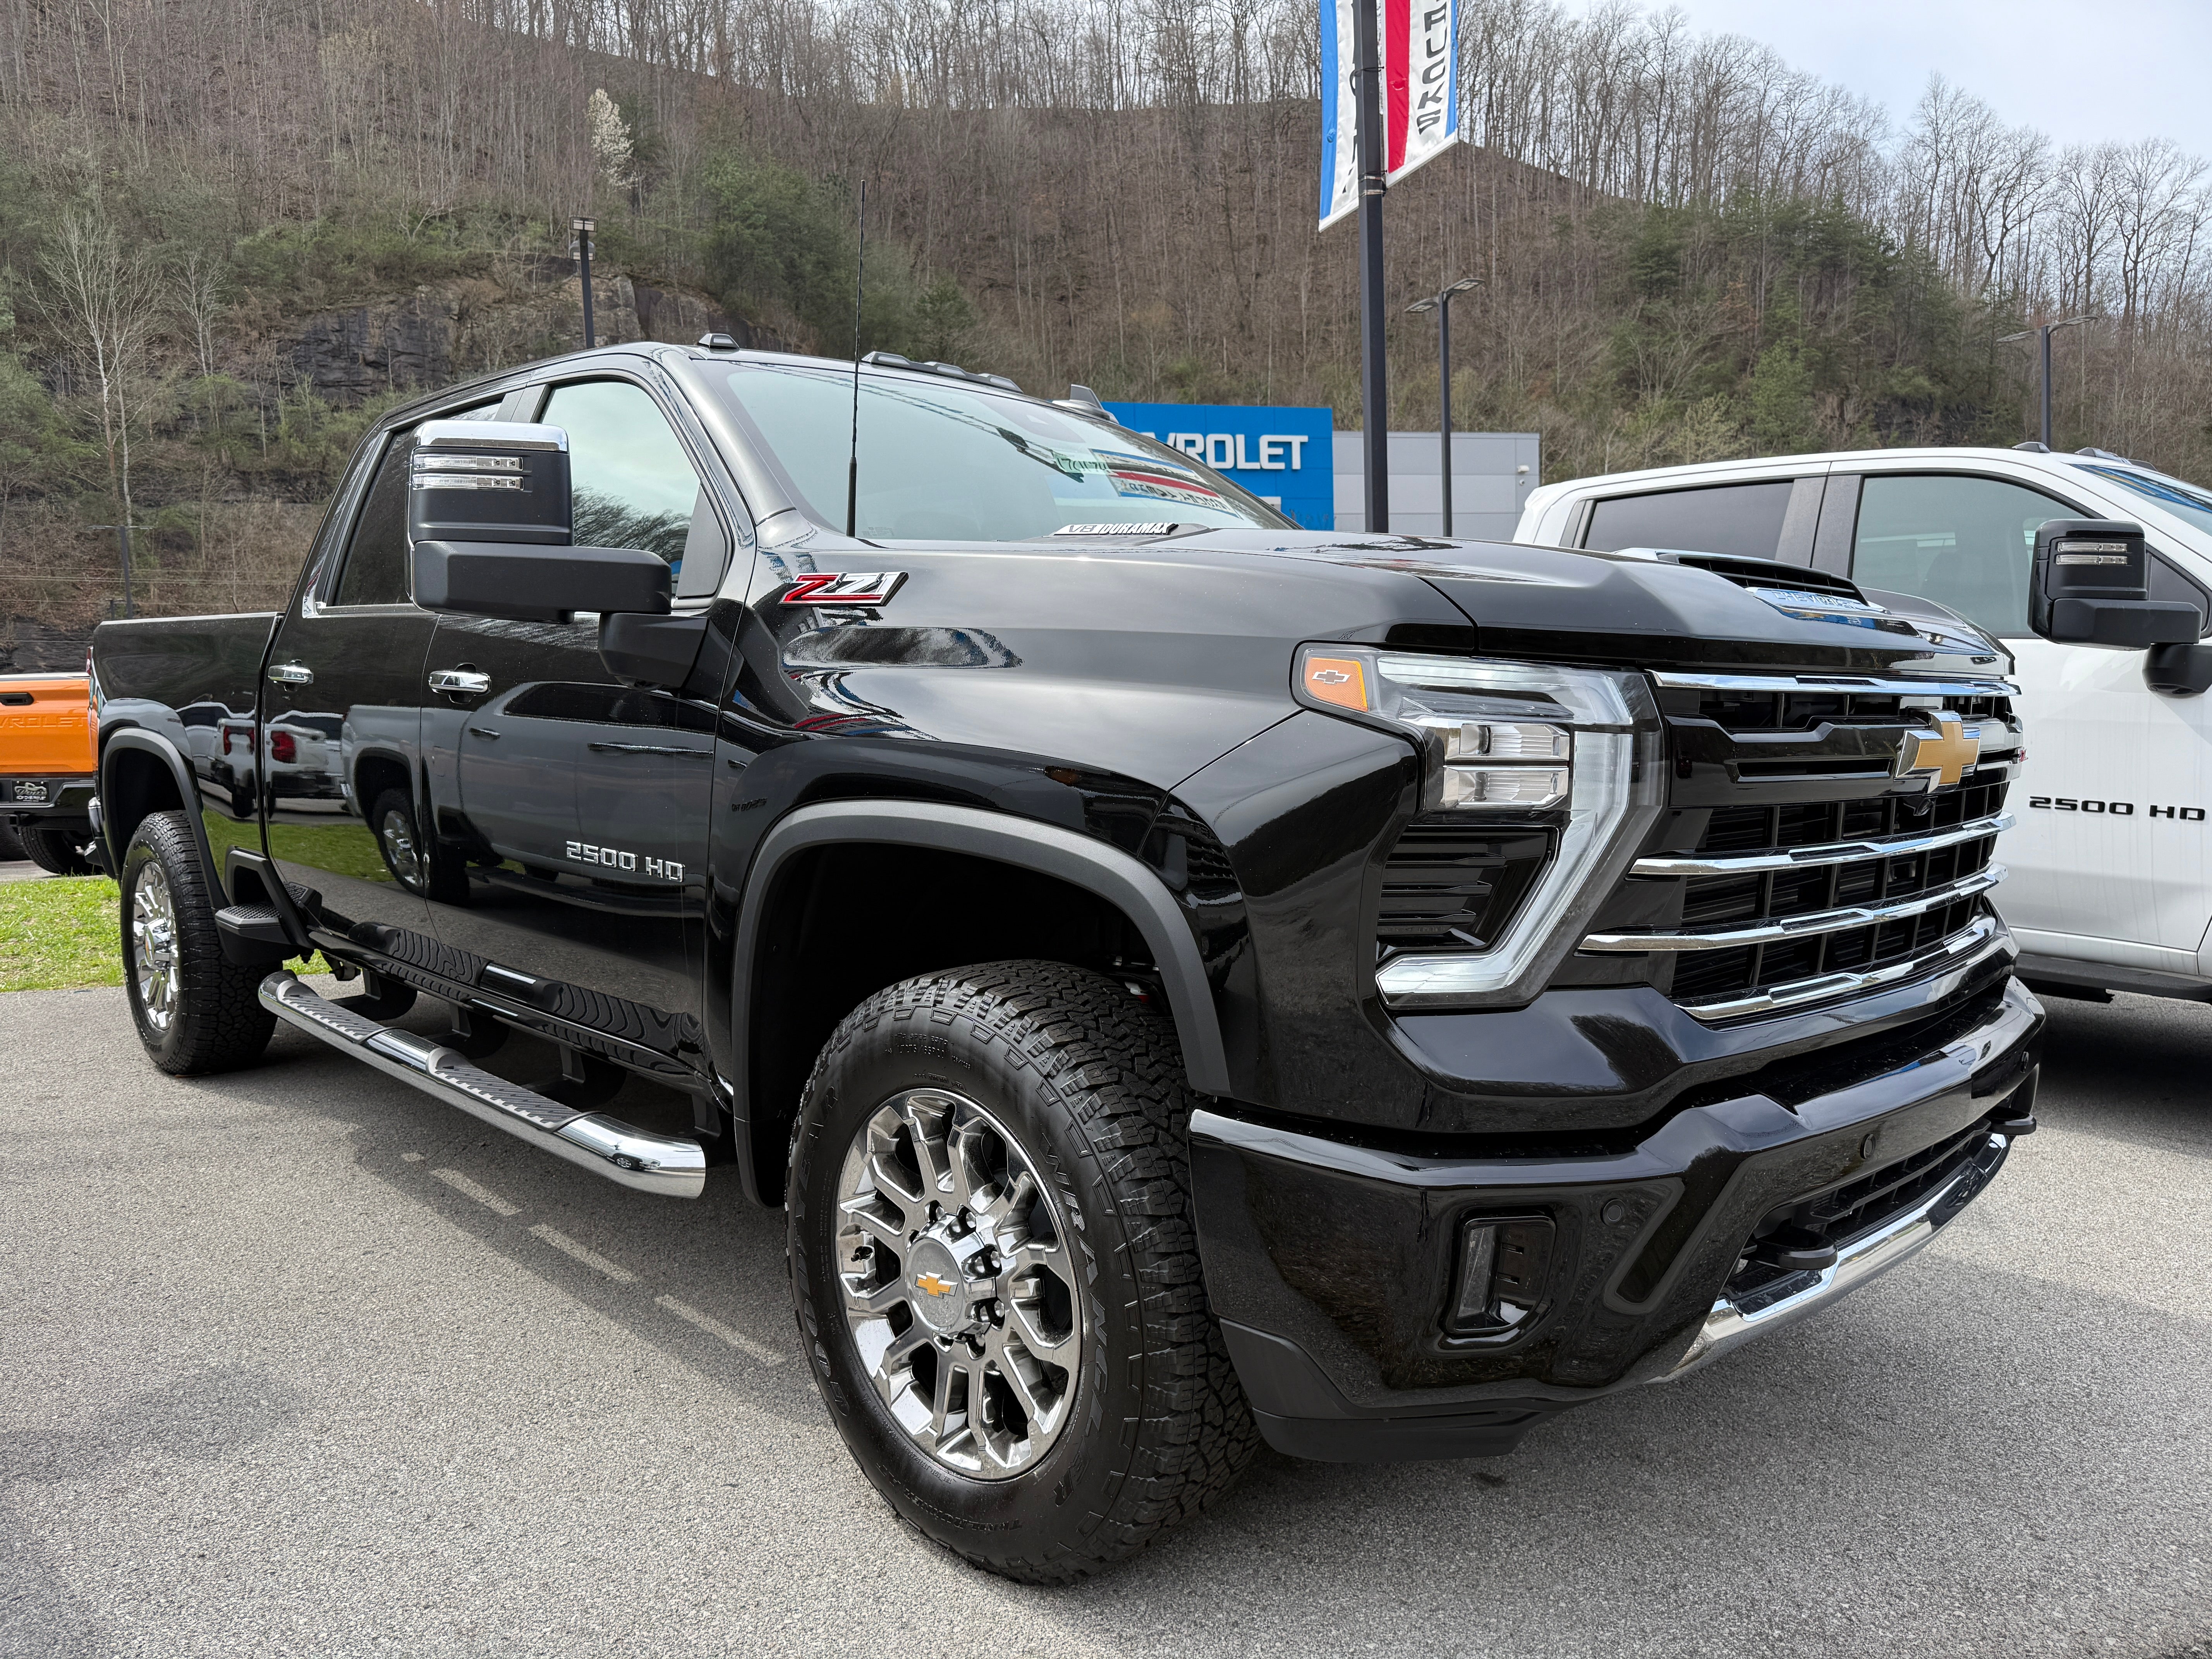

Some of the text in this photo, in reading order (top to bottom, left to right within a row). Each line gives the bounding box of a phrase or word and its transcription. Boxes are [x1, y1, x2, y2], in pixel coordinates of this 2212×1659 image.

[1417, 0, 1447, 135] RUCKS
[1140, 432, 1309, 470] ROLET
[1099, 522, 1175, 534] DURAMAX
[780, 571, 909, 607] Z71
[2029, 796, 2205, 821] 2500 HD
[566, 841, 685, 883] 2500 HD
[794, 1086, 849, 1416] GOODYEAR
[1038, 1133, 1108, 1507] WRANGLER
